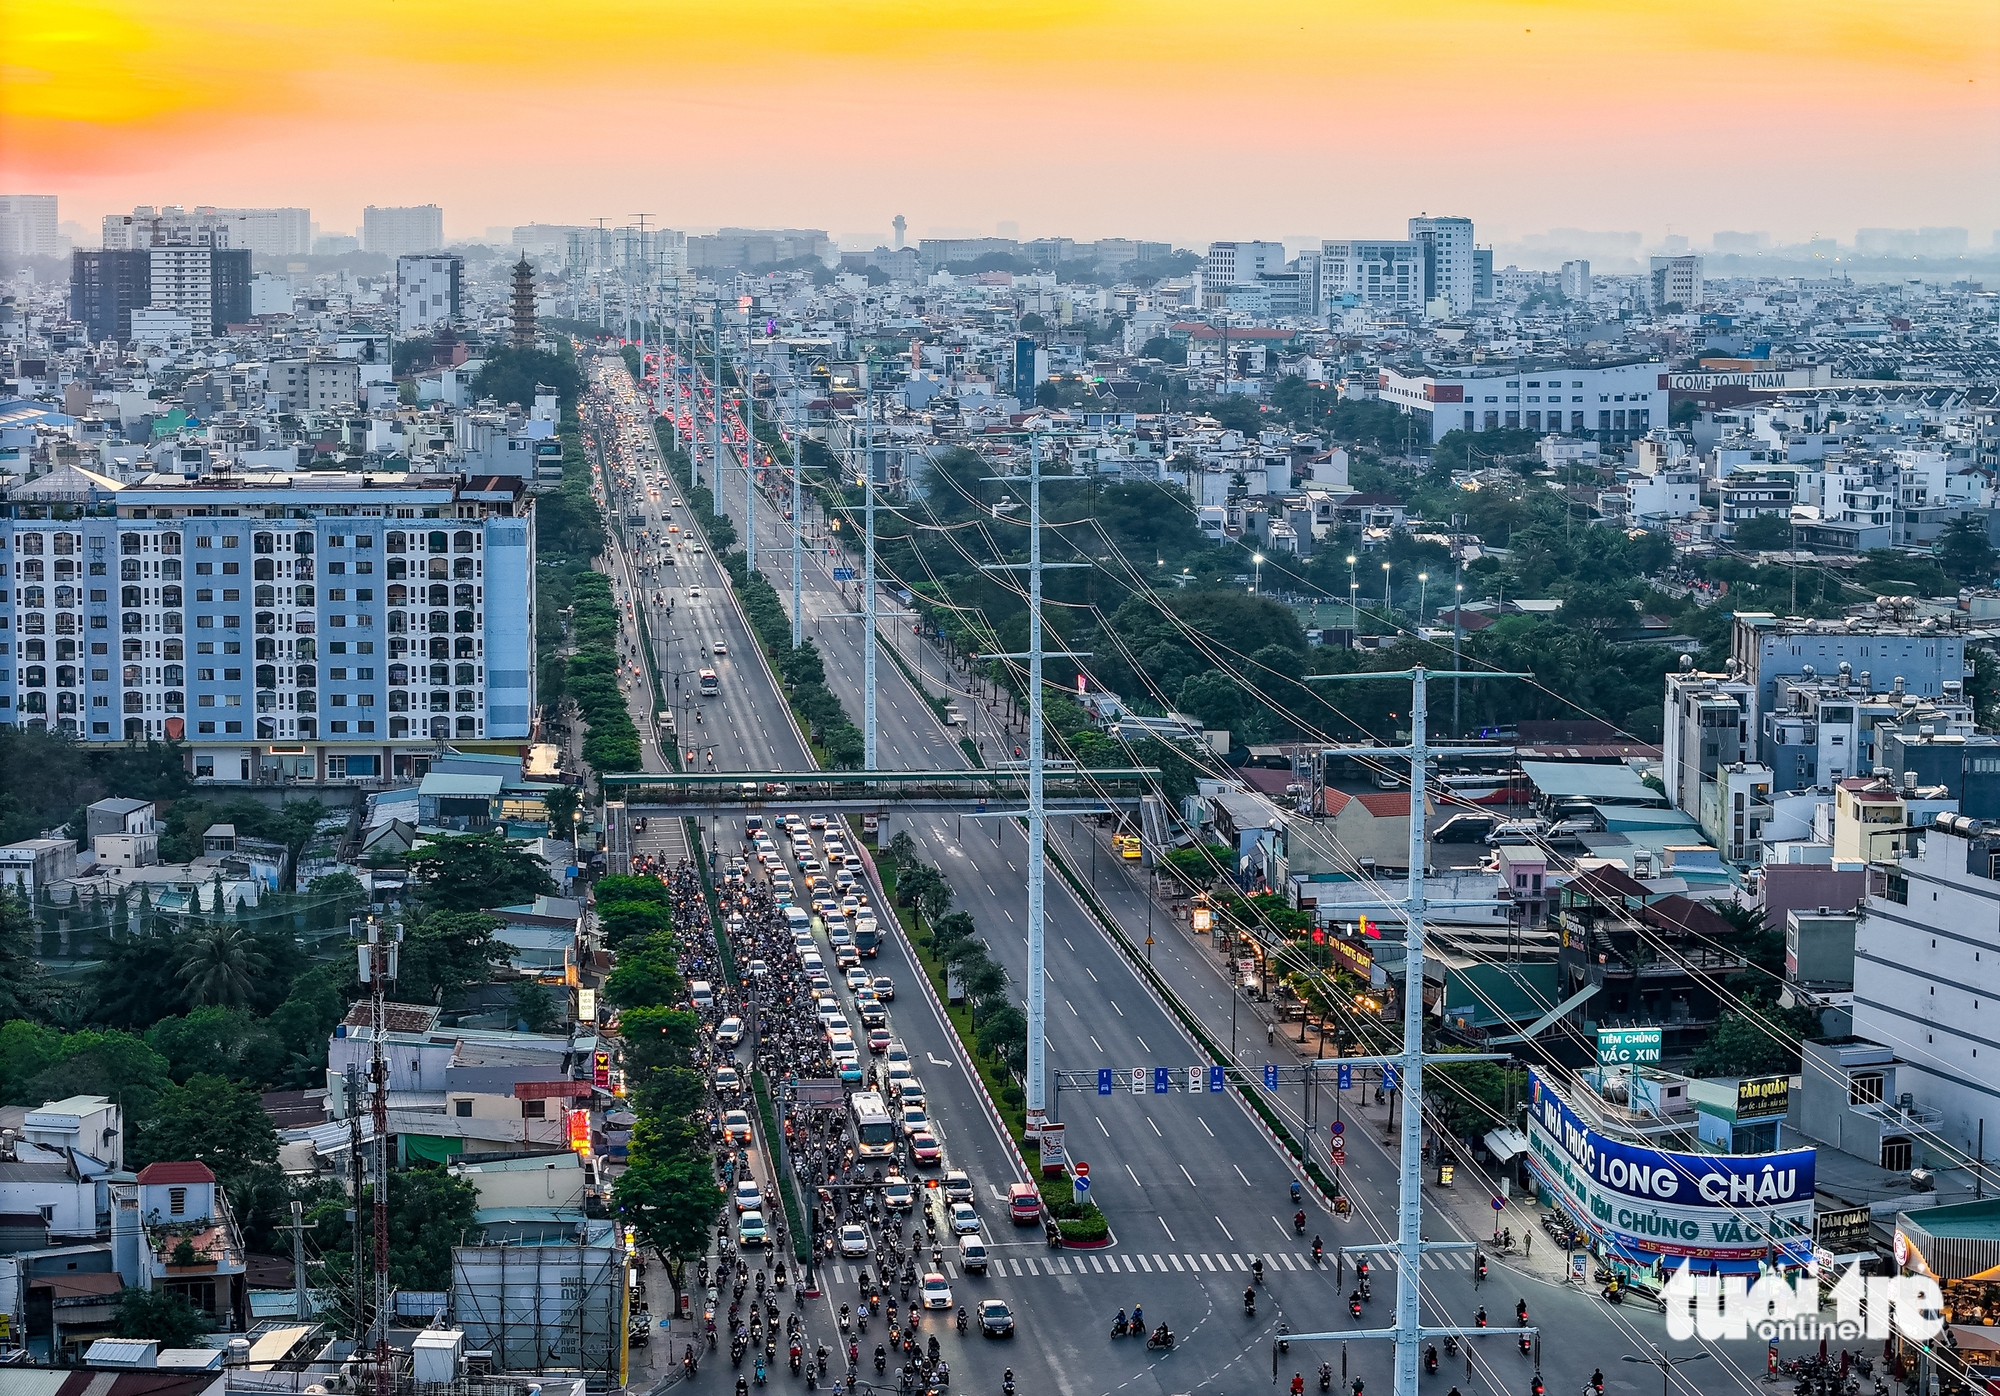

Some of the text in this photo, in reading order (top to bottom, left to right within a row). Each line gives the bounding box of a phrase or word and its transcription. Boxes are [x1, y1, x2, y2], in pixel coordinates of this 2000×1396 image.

[1732, 374, 1786, 388] VIETNAM
[1600, 1032, 1660, 1044] TIÊM CHỦNG
[1600, 1045, 1659, 1062] VẮC XIN
[1740, 1082, 1760, 1098] TÂM
[1544, 1100, 1796, 1203] NHÀ THUỐC LONG CHÂU
[1618, 1208, 1700, 1242] CHỦNG
[1712, 1214, 1764, 1243] VẮC
